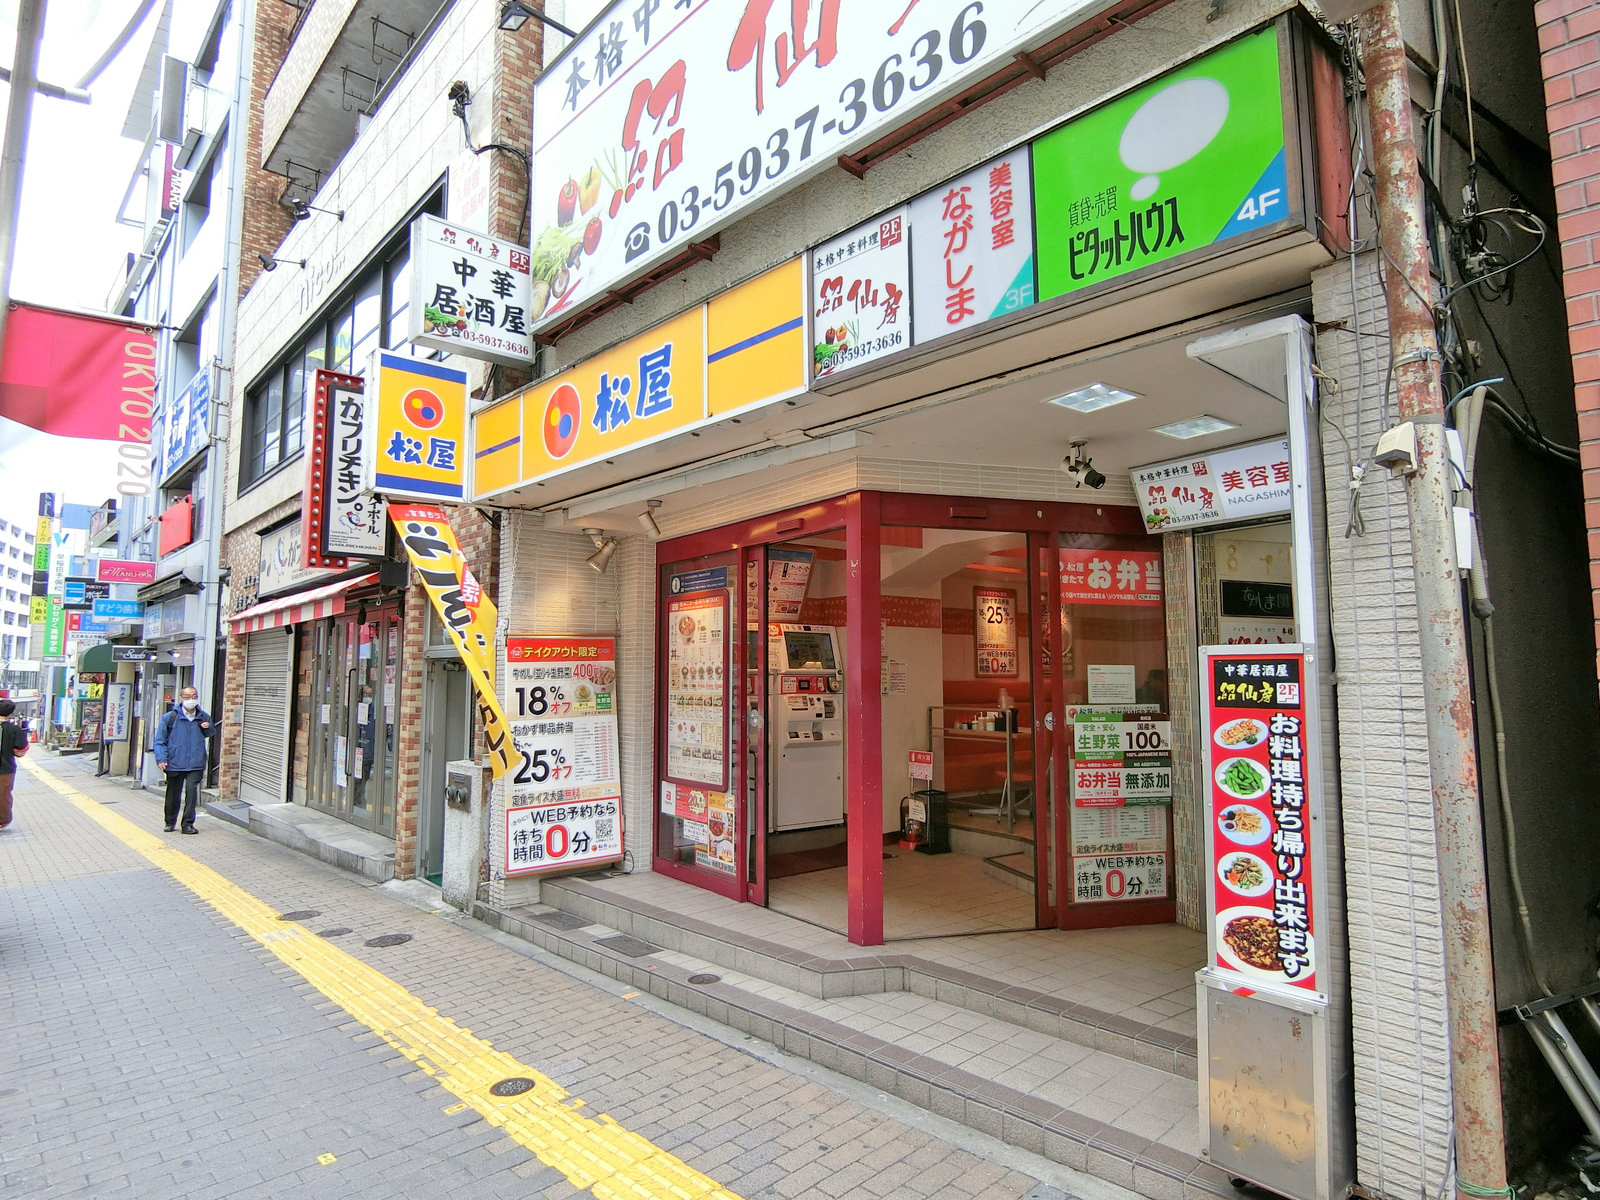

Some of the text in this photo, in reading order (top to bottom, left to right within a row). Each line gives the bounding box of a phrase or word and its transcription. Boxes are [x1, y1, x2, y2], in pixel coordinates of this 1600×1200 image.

[658, 1, 988, 244] 03-5937-3636
[989, 161, 1015, 252] 美容室
[1068, 186, 1118, 229] 賃貸・売買
[1237, 188, 1281, 220] 4F
[815, 217, 902, 272] 本格中華料理 2F
[1069, 197, 1185, 281] ピタットハウス
[511, 250, 529, 268] 2F
[943, 186, 975, 326] ながしま
[453, 257, 516, 299] 中華
[1005, 286, 1032, 310] 3F
[430, 284, 528, 336] 居酒屋
[463, 329, 529, 355] 03-5937-3636
[832, 330, 903, 365] 03-5937-3636
[592, 343, 673, 434] 松屋
[117, 424, 152, 496] 2020
[386, 431, 456, 471] 松屋
[1139, 465, 1190, 483] 本格中華料理
[1221, 461, 1290, 493] 美容室
[1172, 510, 1219, 525] 03-5937-3636
[1067, 563, 1084, 572] 松屋
[1087, 557, 1161, 591] お弁当
[524, 646, 597, 658] テイクアウト限定
[1224, 664, 1288, 678] 中華居酒屋
[515, 686, 565, 716] 18%
[1279, 683, 1297, 696] 2F
[550, 702, 571, 715] オフ
[513, 721, 574, 737] おかず単品弁当
[1082, 724, 1115, 732] 安全・安心
[1078, 733, 1120, 750] 生野菜
[514, 749, 566, 785] 25%
[551, 765, 572, 780] オフ
[1078, 771, 1121, 789] お弁当
[1125, 772, 1170, 789] 無添加
[531, 802, 616, 825] WEB予約なら
[513, 828, 543, 845] 待ち
[546, 824, 569, 858] 0
[572, 831, 590, 853] 分
[1269, 713, 1308, 976] お料理持ち帰り出来ます
[513, 845, 543, 862] 時間
[1096, 855, 1163, 869] WEB予約なら
[1078, 872, 1101, 884] 待ち
[1106, 869, 1125, 897] 0
[1127, 877, 1142, 894] 分
[1078, 885, 1101, 897] 時間
